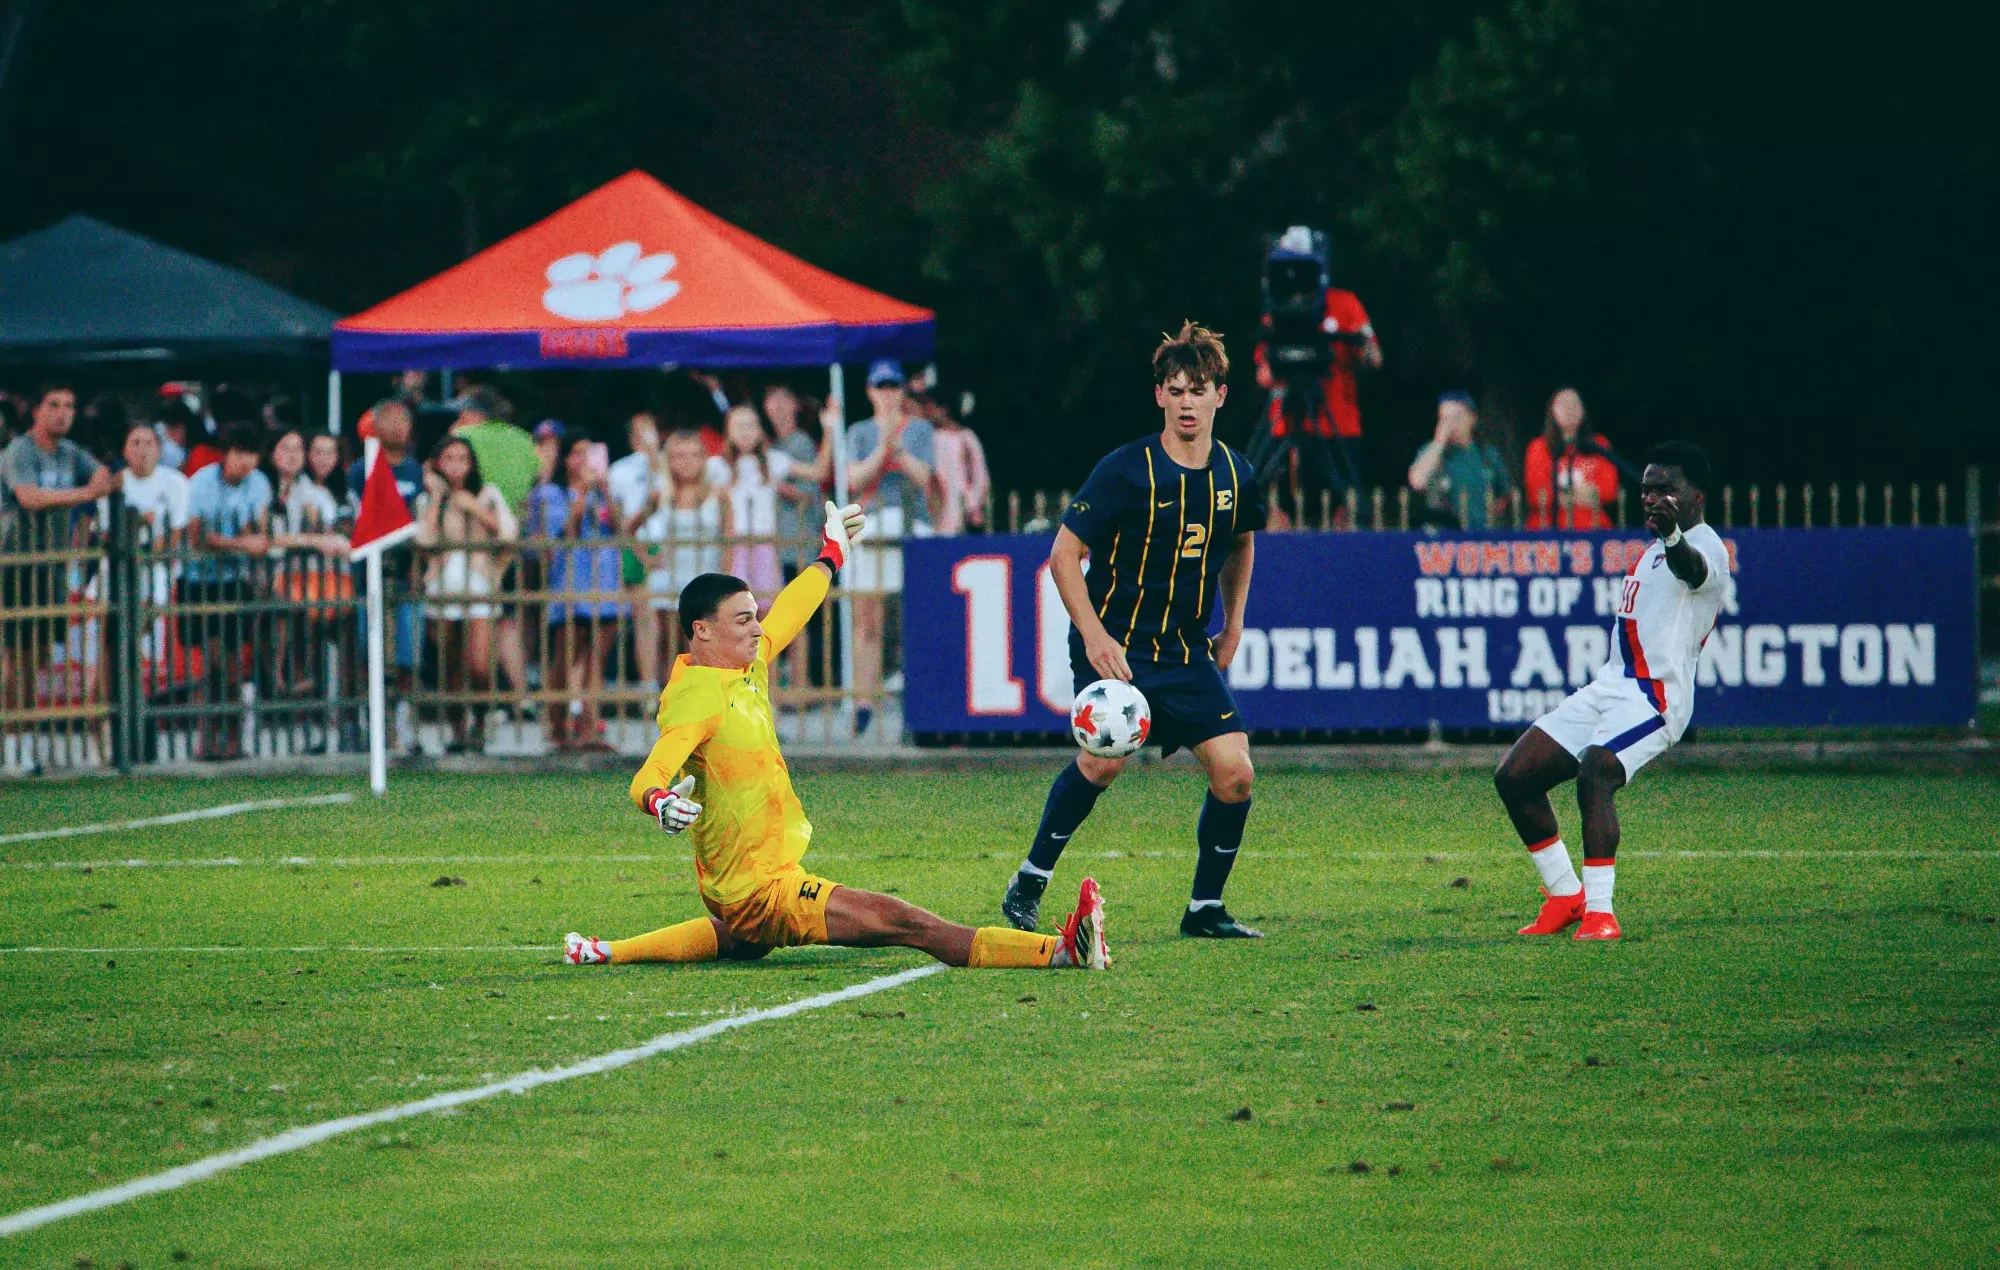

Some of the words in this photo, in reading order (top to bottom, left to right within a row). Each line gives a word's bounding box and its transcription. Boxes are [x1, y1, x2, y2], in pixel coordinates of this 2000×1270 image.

[1181, 523, 1206, 558] 2
[1415, 541, 1593, 576] WOMEN'S
[1414, 577, 1519, 618] RING
[1528, 577, 1583, 618] OF
[1227, 626, 1491, 690] DELIAH
[1510, 623, 1936, 689] ARNGTON
